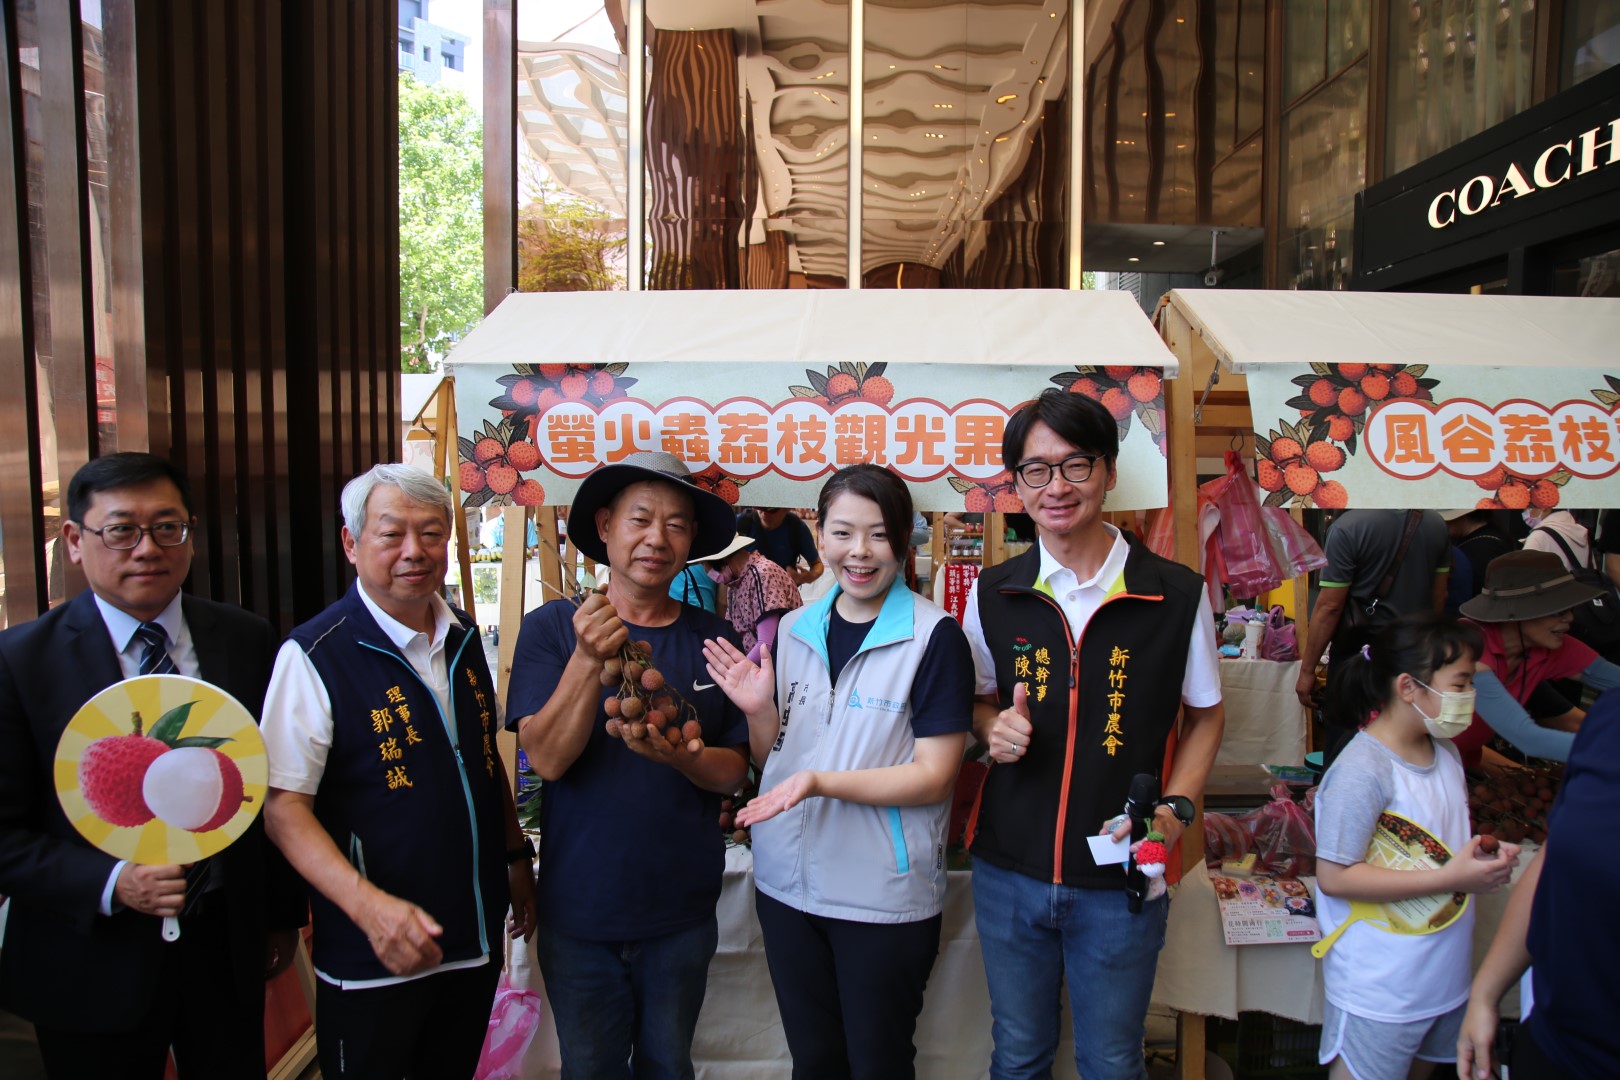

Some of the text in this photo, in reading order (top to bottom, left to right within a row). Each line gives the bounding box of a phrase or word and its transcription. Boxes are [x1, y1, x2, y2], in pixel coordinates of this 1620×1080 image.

[1428, 118, 1620, 229] COACH
[547, 413, 1005, 466] 螢火蟲荔枝觀光果
[1384, 413, 1620, 465] 風谷荔枝
[1035, 646, 1051, 702] 總幹事
[1102, 645, 1131, 757] 新竹市農會
[385, 685, 424, 747] 理事長
[370, 707, 414, 791] 郭瑞誠
